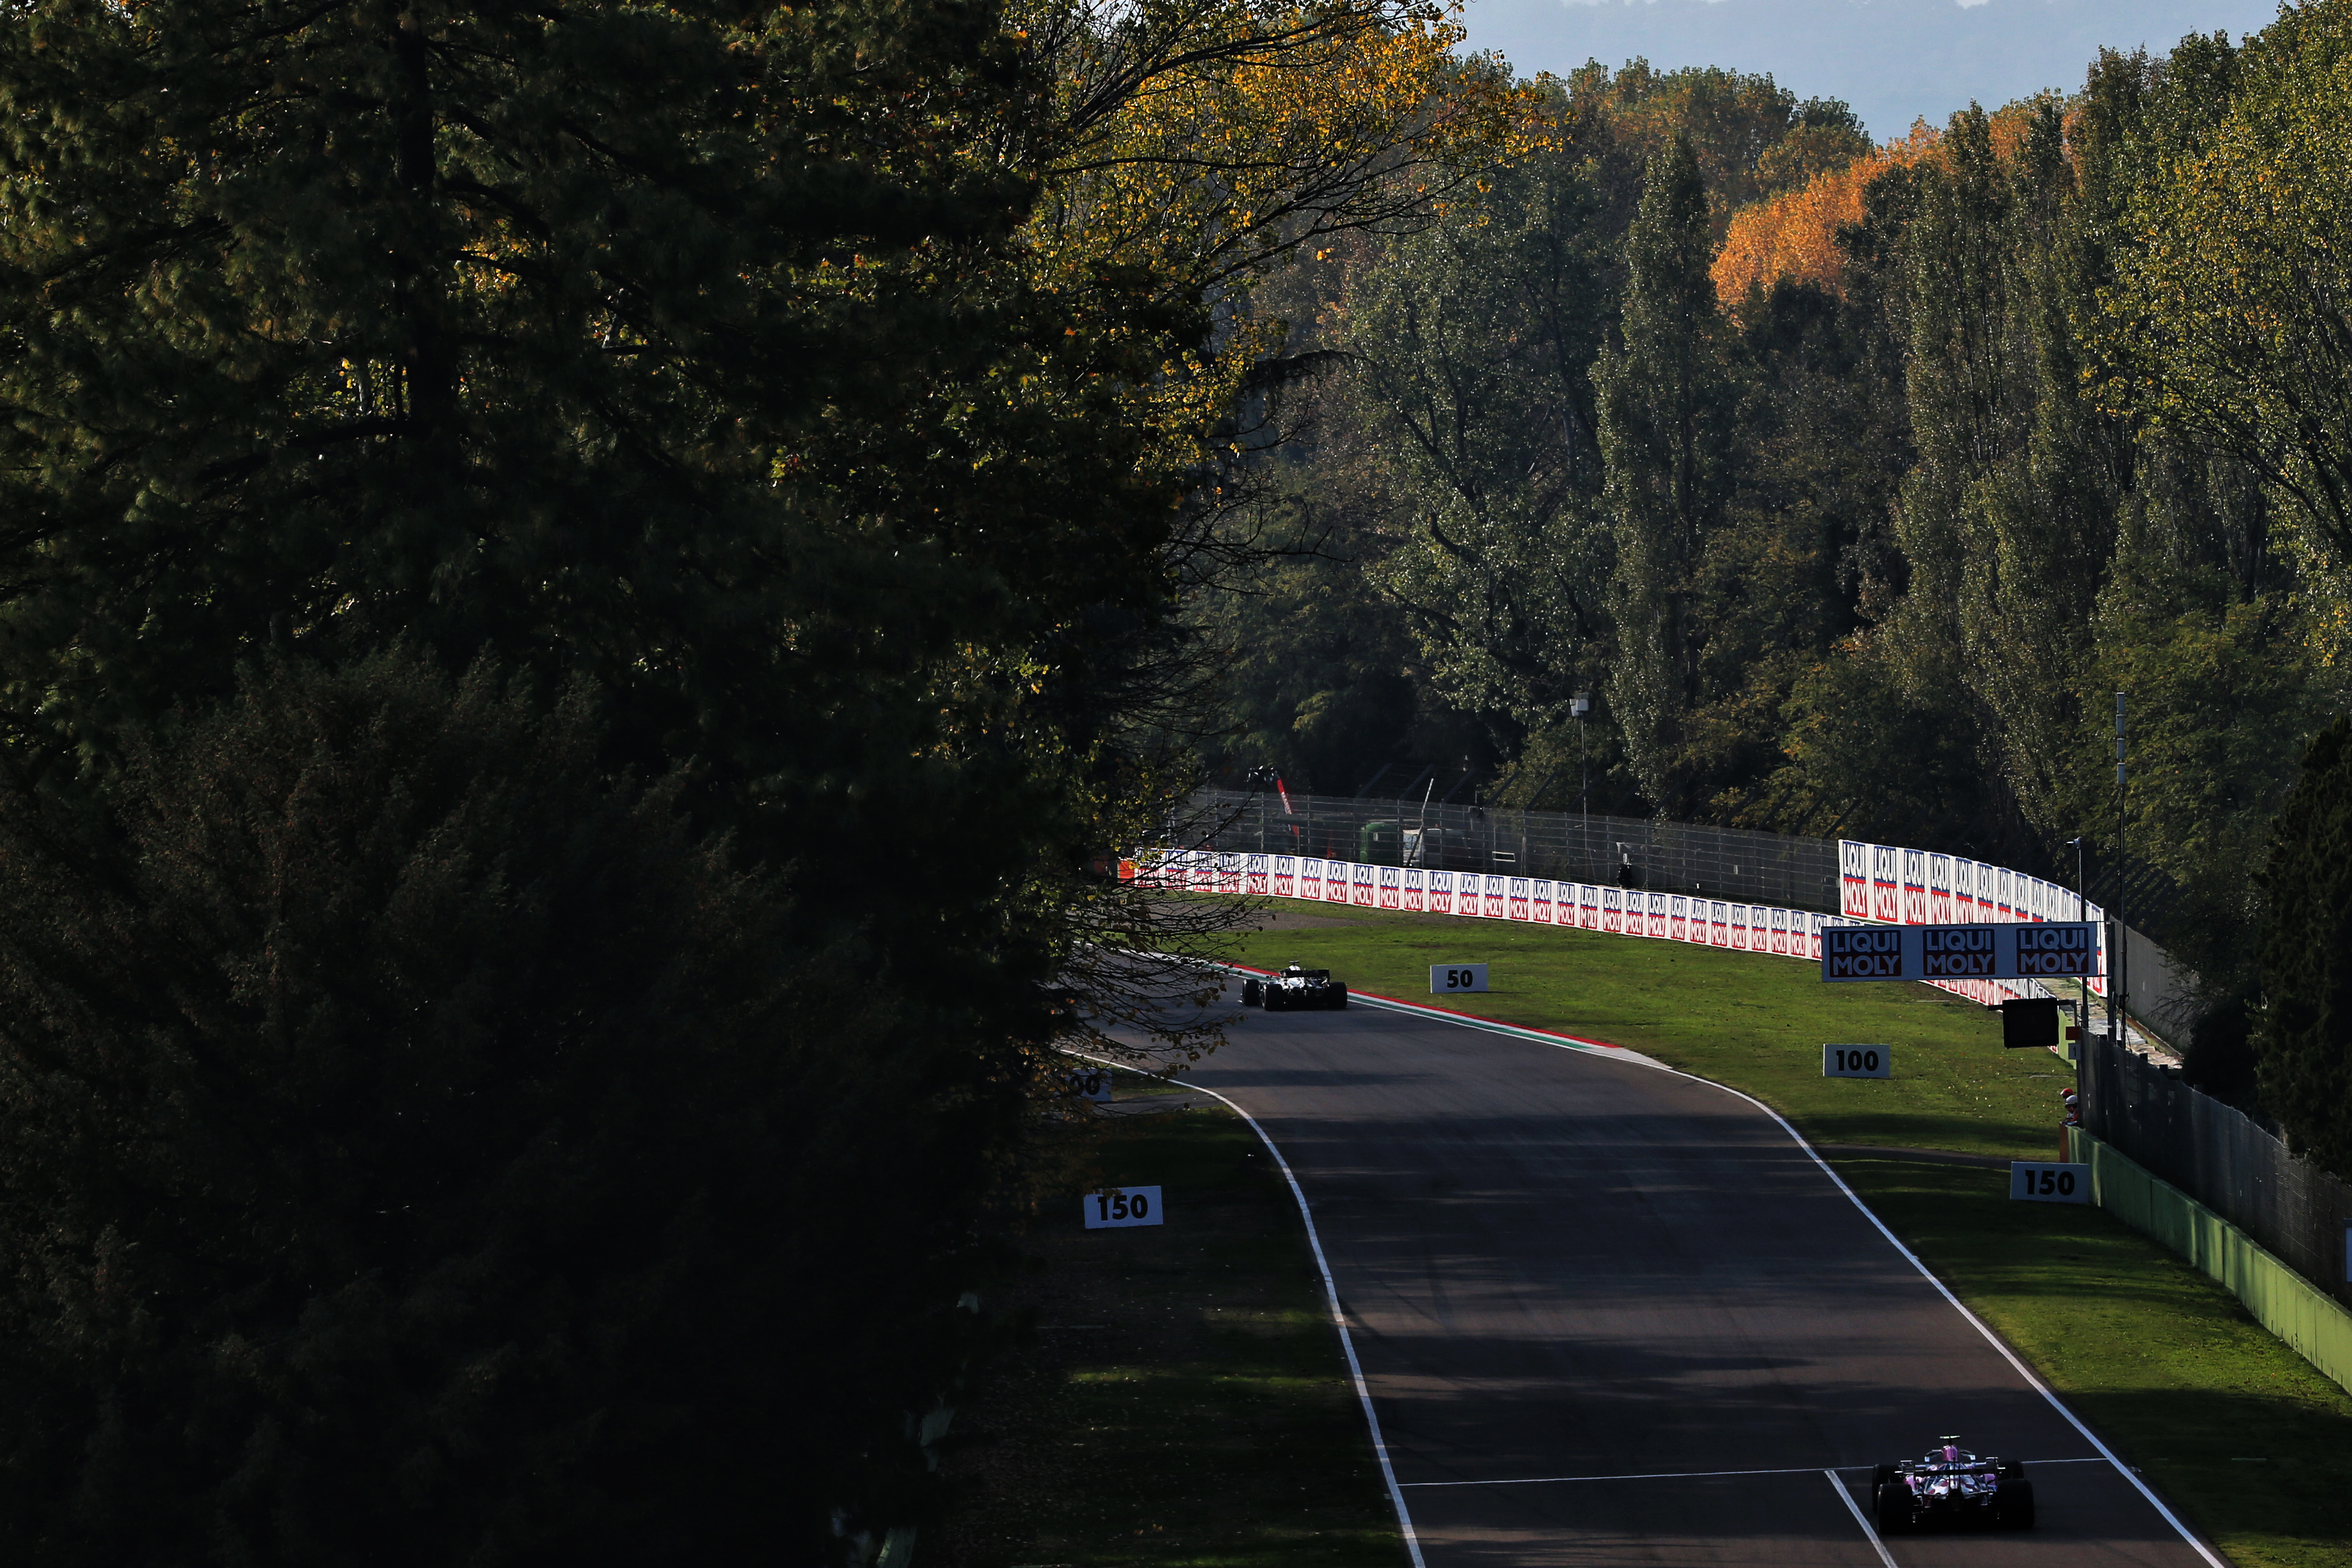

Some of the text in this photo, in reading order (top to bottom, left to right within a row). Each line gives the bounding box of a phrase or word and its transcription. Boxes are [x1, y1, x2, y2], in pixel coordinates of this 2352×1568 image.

[1249, 855, 1267, 873] LIQUI
[1275, 856, 1293, 875] LIQUI
[1303, 858, 1322, 878] LIQUI
[1843, 843, 1865, 877] LIQUI
[1875, 848, 1896, 882] LIQUI
[1905, 852, 1924, 886] LIQUI
[1328, 862, 1347, 881] LIQUI
[1354, 865, 1373, 884] LIQUI
[1381, 868, 1399, 887] LIQUI
[1406, 870, 1423, 889] LIQUI
[1931, 856, 1950, 890] LIQUI
[1956, 861, 1972, 896] LIQUI
[1247, 876, 1267, 892] MOLY
[1275, 877, 1293, 895] MOLY
[1302, 878, 1319, 897] MOLY
[1328, 882, 1347, 901] MOLY
[1430, 872, 1452, 892] LIQUI
[1461, 875, 1479, 894] LIQUI
[1486, 877, 1503, 895] LIQUI
[1510, 879, 1528, 898] LIQUI
[1534, 881, 1551, 900] LIQUI
[1978, 866, 1993, 901] LIQUI
[1999, 871, 2010, 906] LIQUI
[1354, 886, 1373, 904] MOLY
[1380, 889, 1398, 906] MOLY
[1405, 891, 1422, 909] MOLY
[1430, 892, 1451, 911] MOLY
[1558, 883, 1574, 903] LIQUI
[1581, 887, 1597, 906] LIQUI
[1604, 890, 1621, 909] LIQUI
[1627, 893, 1643, 912] LIQUI
[1845, 881, 1867, 914] MOLY
[1875, 886, 1896, 918] MOLY
[1460, 896, 1478, 914] MOLY
[1485, 897, 1503, 916] MOLY
[1510, 900, 1528, 919] MOLY
[1534, 902, 1551, 921] MOLY
[1558, 905, 1574, 924] MOLY
[1649, 895, 1665, 915] LIQUI
[1672, 897, 1686, 916] LIQUI
[1692, 900, 1706, 920] LIQUI
[1712, 903, 1726, 923] LIQUI
[1906, 890, 1925, 923] MOLY
[1932, 894, 1950, 924] MOLY
[1581, 907, 1597, 927] MOLY
[1603, 911, 1621, 931] MOLY
[1627, 914, 1642, 933] MOLY
[1649, 916, 1665, 936] MOLY
[1732, 906, 1746, 926] LIQUI
[1752, 908, 1766, 927] LIQUI
[1772, 910, 1786, 930] LIQUI
[1792, 912, 1805, 932] LIQUI
[1671, 919, 1685, 938] MOLY
[1691, 922, 1705, 941] MOLY
[1712, 925, 1726, 945] MOLY
[1732, 927, 1745, 947] MOLY
[1752, 930, 1766, 950] MOLY
[1772, 932, 1786, 952] MOLY
[1791, 934, 1805, 955] MOLY
[1812, 937, 1821, 957] MO
[1833, 932, 1897, 953] LIQUI
[1927, 931, 1991, 951] LIQUI
[2020, 929, 2085, 950] LIQUI
[1833, 955, 1899, 975] MOLY
[1927, 954, 1993, 973] MOLY
[2020, 952, 2087, 972] MOLY
[1447, 970, 1473, 988] 50
[1836, 1050, 1879, 1071] 100
[2073, 1046, 2076, 1058] 1
[2025, 1169, 2075, 1196] 150
[1098, 1194, 1148, 1221] 150
